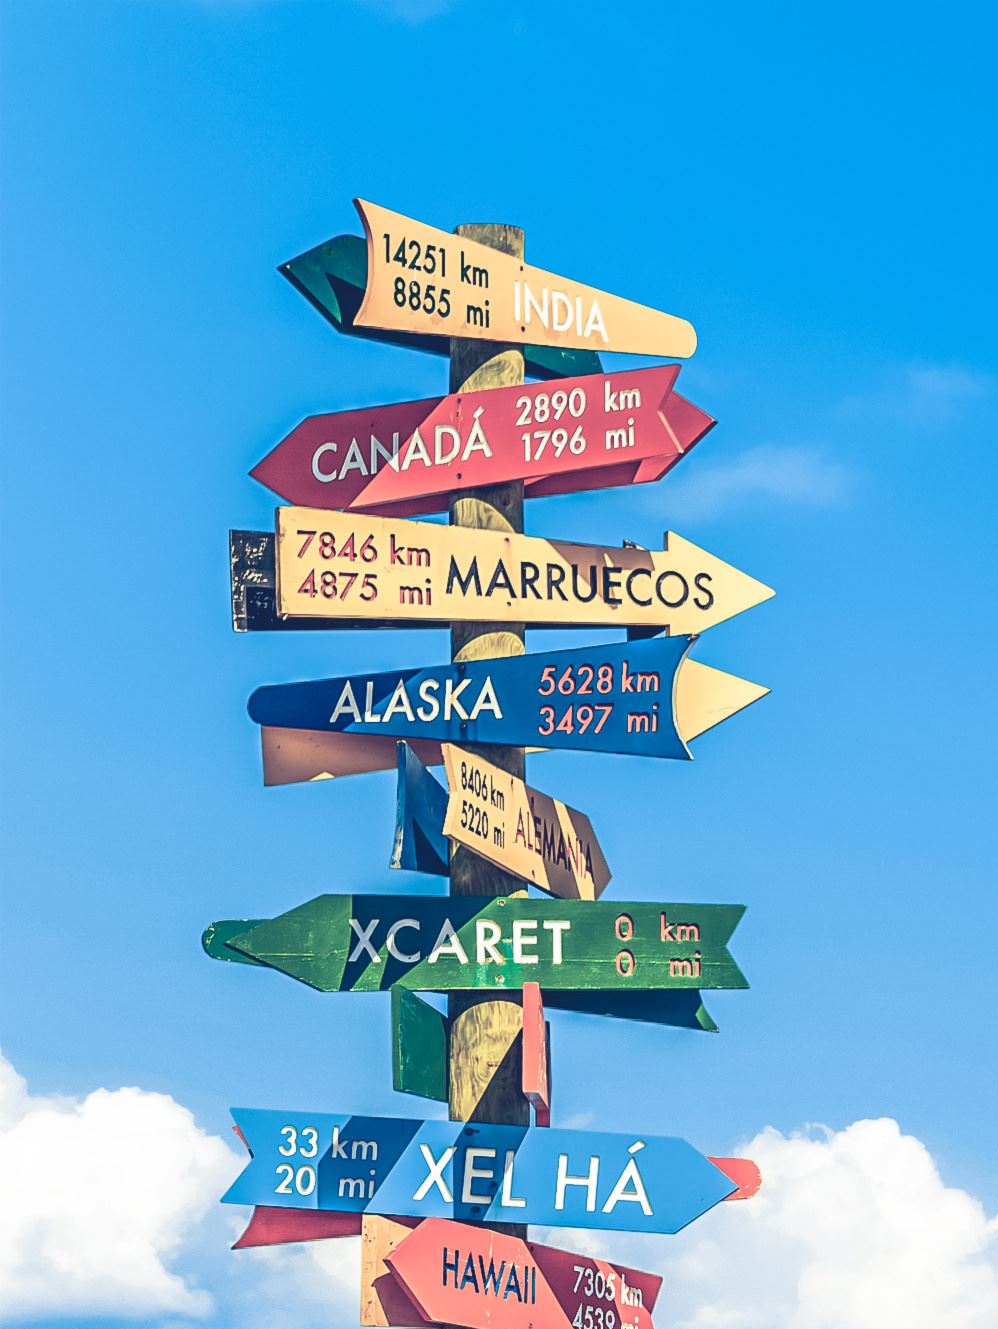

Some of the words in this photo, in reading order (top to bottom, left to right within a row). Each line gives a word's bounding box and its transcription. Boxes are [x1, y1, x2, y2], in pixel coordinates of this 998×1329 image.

[383, 234, 447, 279] 14251
[461, 251, 489, 288] km
[394, 278, 451, 318] 8855
[467, 299, 490, 329] mi
[514, 280, 609, 342] INDIA
[516, 387, 586, 426] 2890
[605, 382, 641, 413] km
[311, 406, 493, 484] CANADÁ
[522, 425, 586, 463] 1796
[606, 418, 635, 449] mi
[297, 530, 377, 563] 7846
[391, 534, 431, 567] km
[297, 568, 378, 602] 4875
[400, 578, 431, 606] mi
[446, 555, 715, 610] MARRUECOS
[330, 675, 503, 723] ALASKA
[538, 664, 613, 696] 5628
[622, 661, 660, 693] km
[538, 704, 612, 736] 3497
[628, 704, 659, 733] mi
[461, 761, 488, 801] 8406
[491, 775, 505, 811] km
[461, 801, 488, 840] 5220
[494, 824, 505, 849] mi
[513, 807, 593, 880] ALEMANIA
[348, 918, 571, 965] XCARET
[615, 913, 634, 941] 0
[660, 911, 700, 941] km
[616, 949, 635, 976] 0
[669, 950, 701, 977] mi
[278, 1125, 319, 1160] 33
[332, 1126, 378, 1161] km
[275, 1163, 316, 1198] 20
[339, 1169, 376, 1199] mi
[413, 1143, 527, 1209] XEL
[555, 1141, 654, 1216] HÁ
[442, 1247, 536, 1305] HAWAII
[573, 1265, 616, 1302] 7305
[619, 1278, 643, 1309] km
